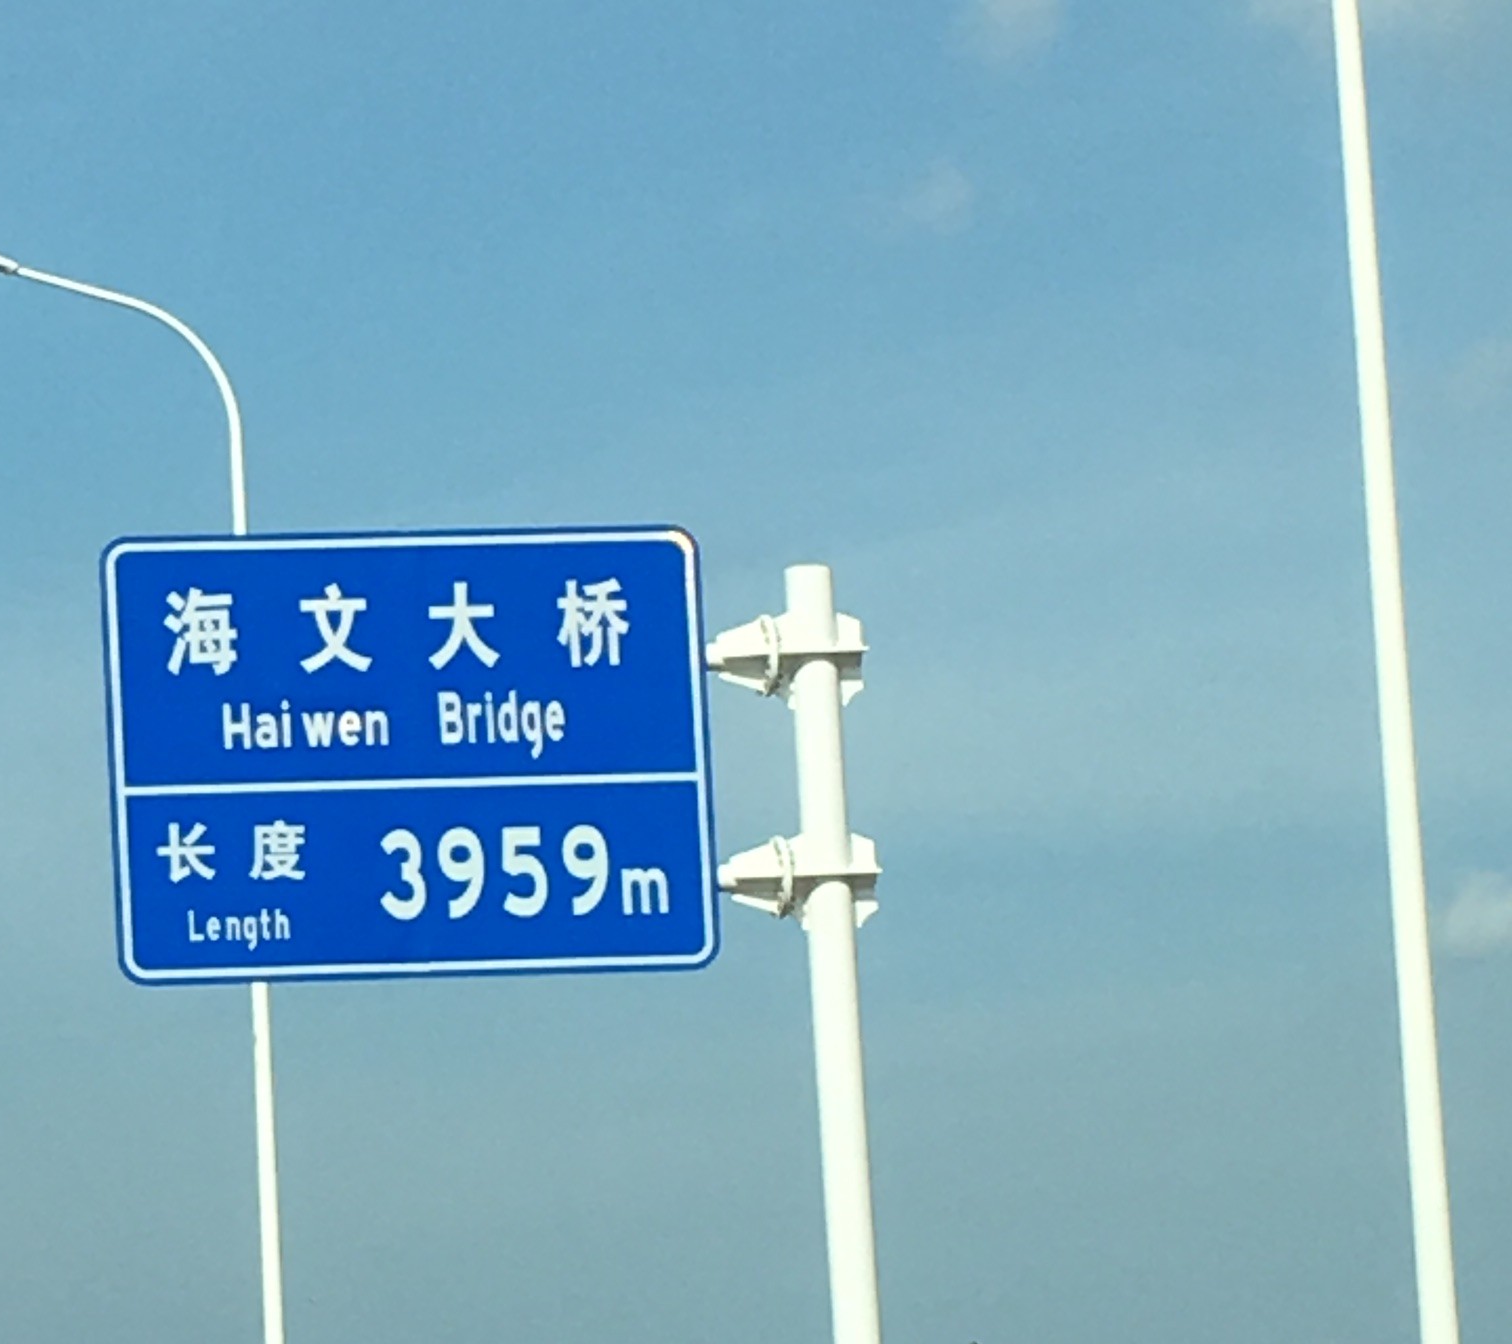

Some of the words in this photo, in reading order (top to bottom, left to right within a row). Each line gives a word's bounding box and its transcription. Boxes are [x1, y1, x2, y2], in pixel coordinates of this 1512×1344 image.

[163, 578, 630, 676] 海文大桥
[437, 690, 567, 759] Bridge
[156, 820, 306, 883] 长度
[187, 909, 291, 951] Length
